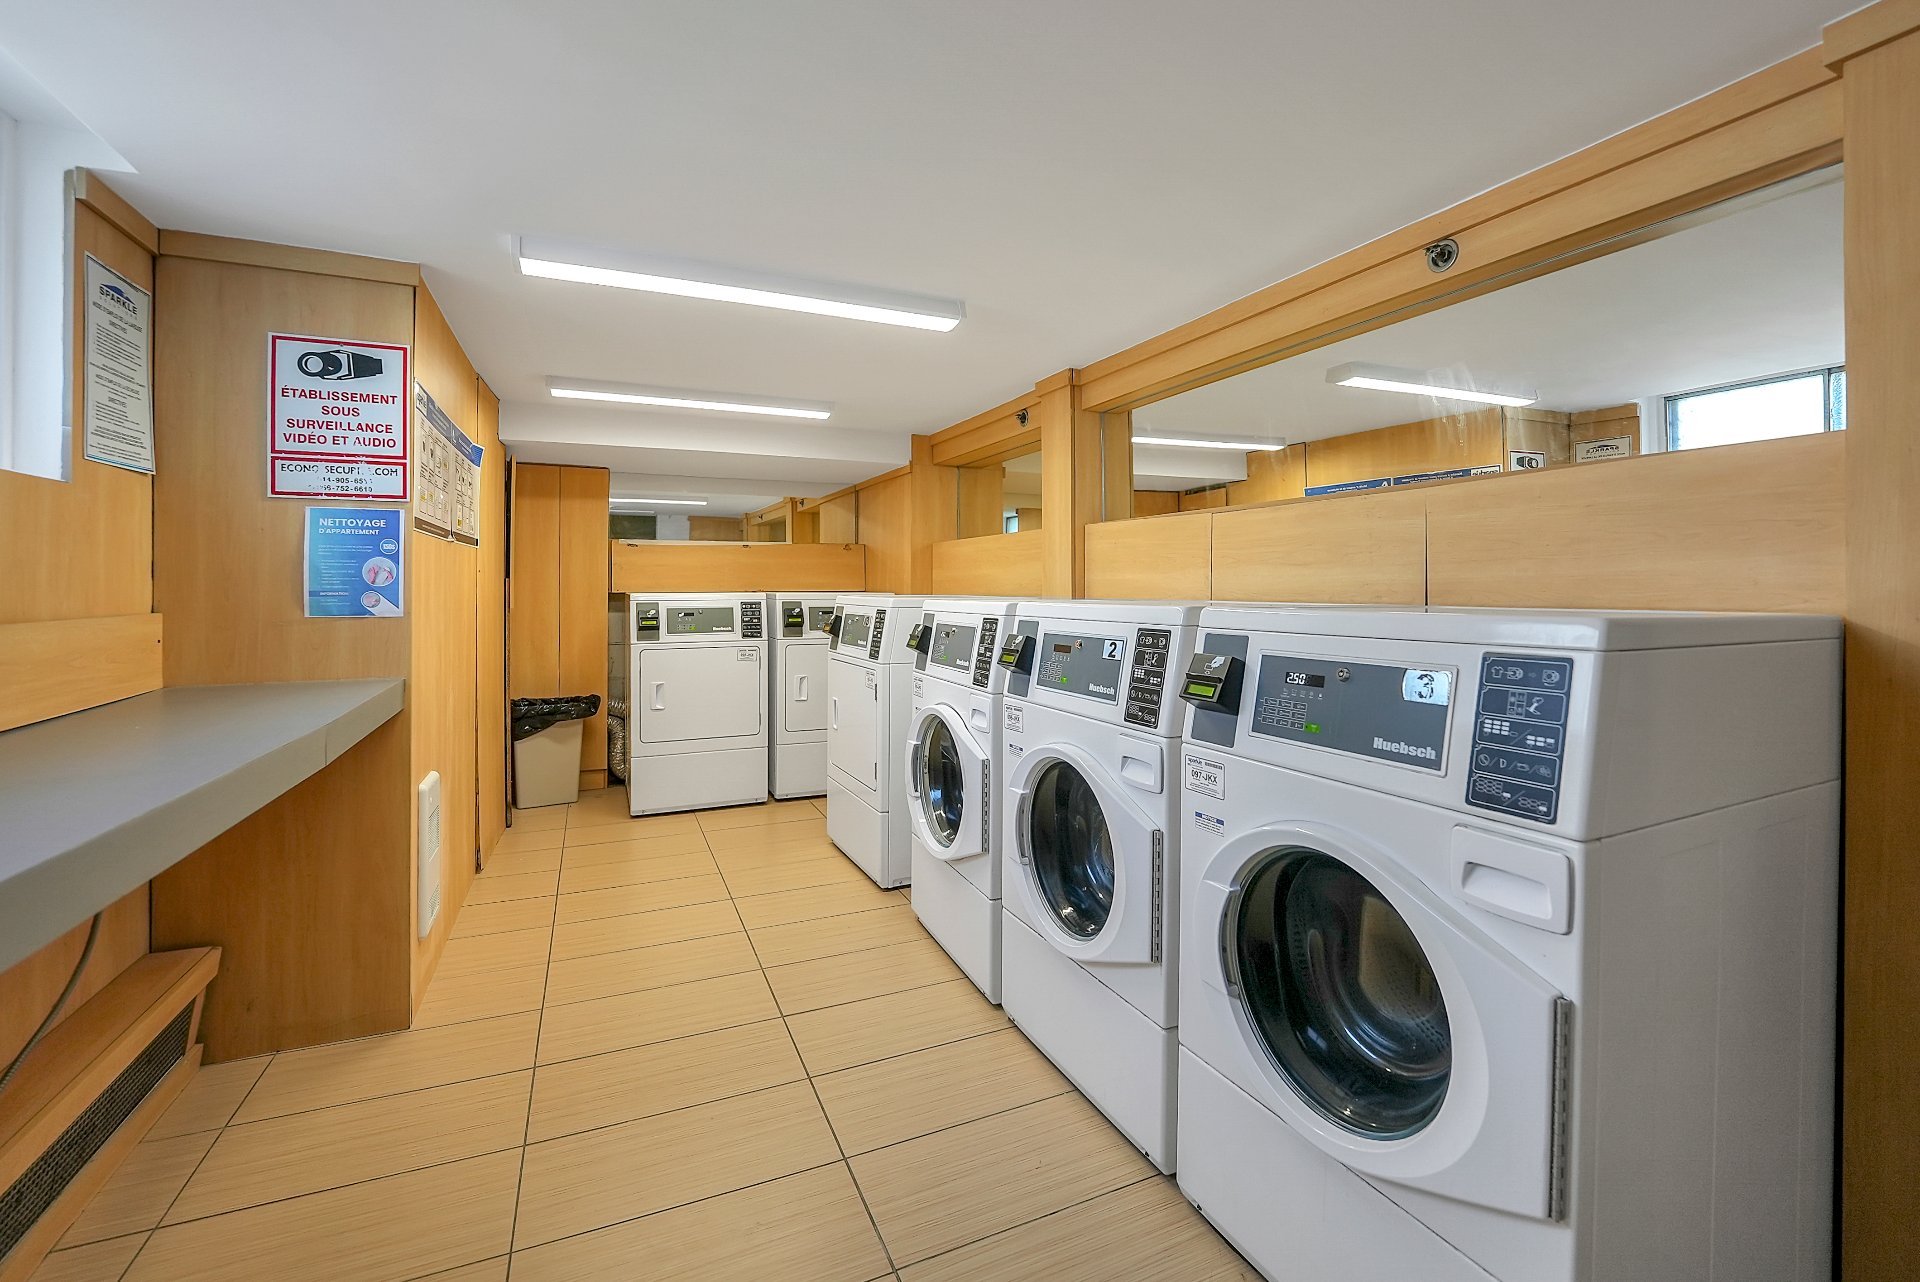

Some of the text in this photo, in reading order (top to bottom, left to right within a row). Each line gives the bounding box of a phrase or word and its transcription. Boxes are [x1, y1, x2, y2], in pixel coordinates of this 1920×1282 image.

[99, 285, 137, 316] SPARKLE
[281, 385, 398, 405] ÉTABLISSEMENT
[321, 405, 360, 417] SOUS
[286, 418, 393, 434] SURVEILLANCE
[283, 431, 396, 449] VIDÉO ET AUDIO
[320, 518, 387, 527] NETTOYAGE
[1107, 641, 1117, 659] 2
[1089, 682, 1115, 696] Huebsch
[1415, 673, 1435, 700] 3
[1373, 736, 1437, 761] Huebsch
[1191, 769, 1218, 784] 097-JKX
